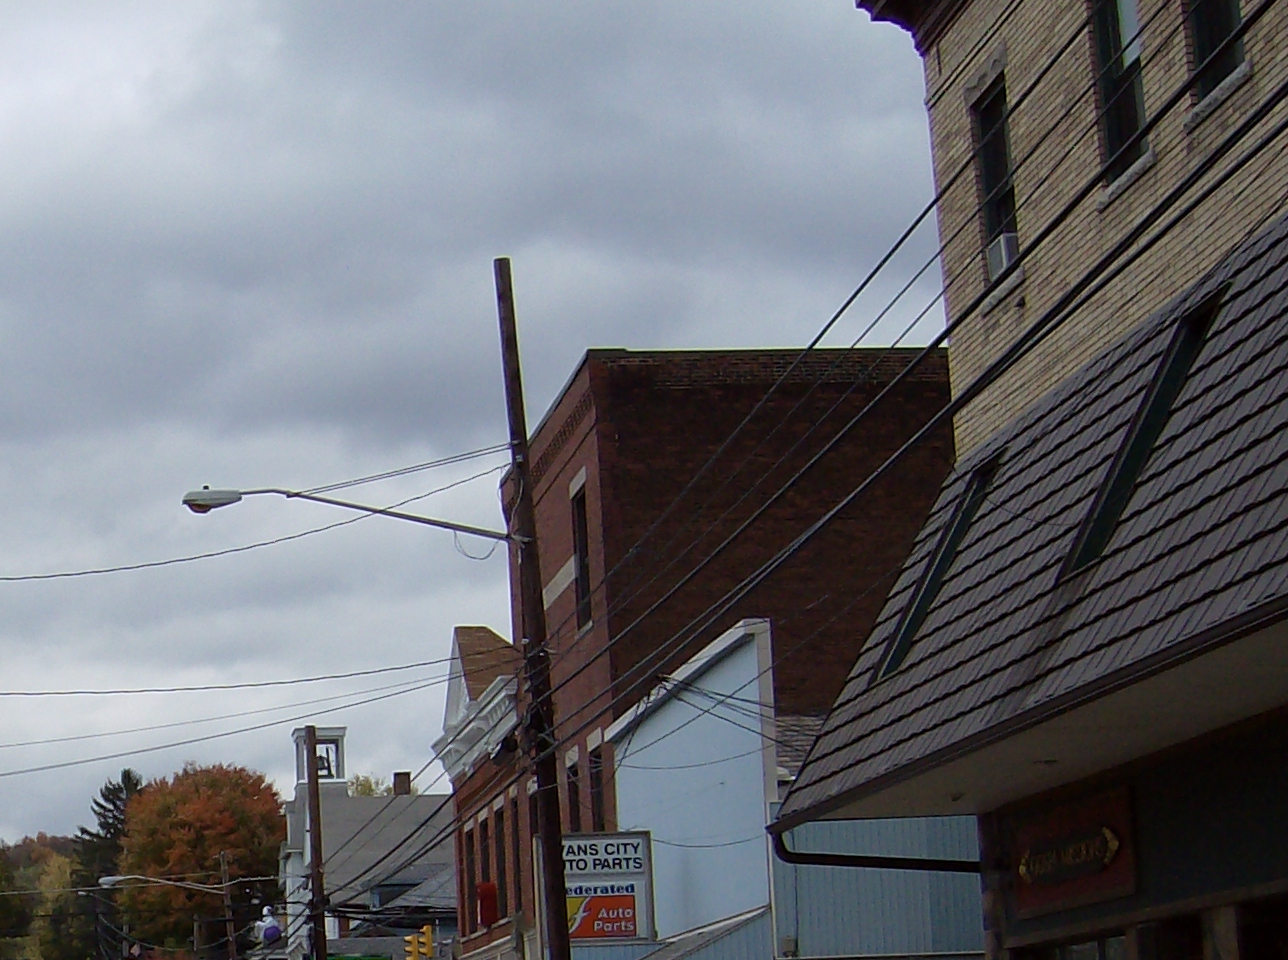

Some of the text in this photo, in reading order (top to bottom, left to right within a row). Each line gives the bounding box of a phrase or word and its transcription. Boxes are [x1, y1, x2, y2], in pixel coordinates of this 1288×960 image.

[563, 843, 640, 856] ANS CITY
[564, 857, 643, 871] TO PARTS
[566, 884, 635, 896] ederated
[598, 907, 634, 919] Auto
[593, 920, 634, 932] Parts
